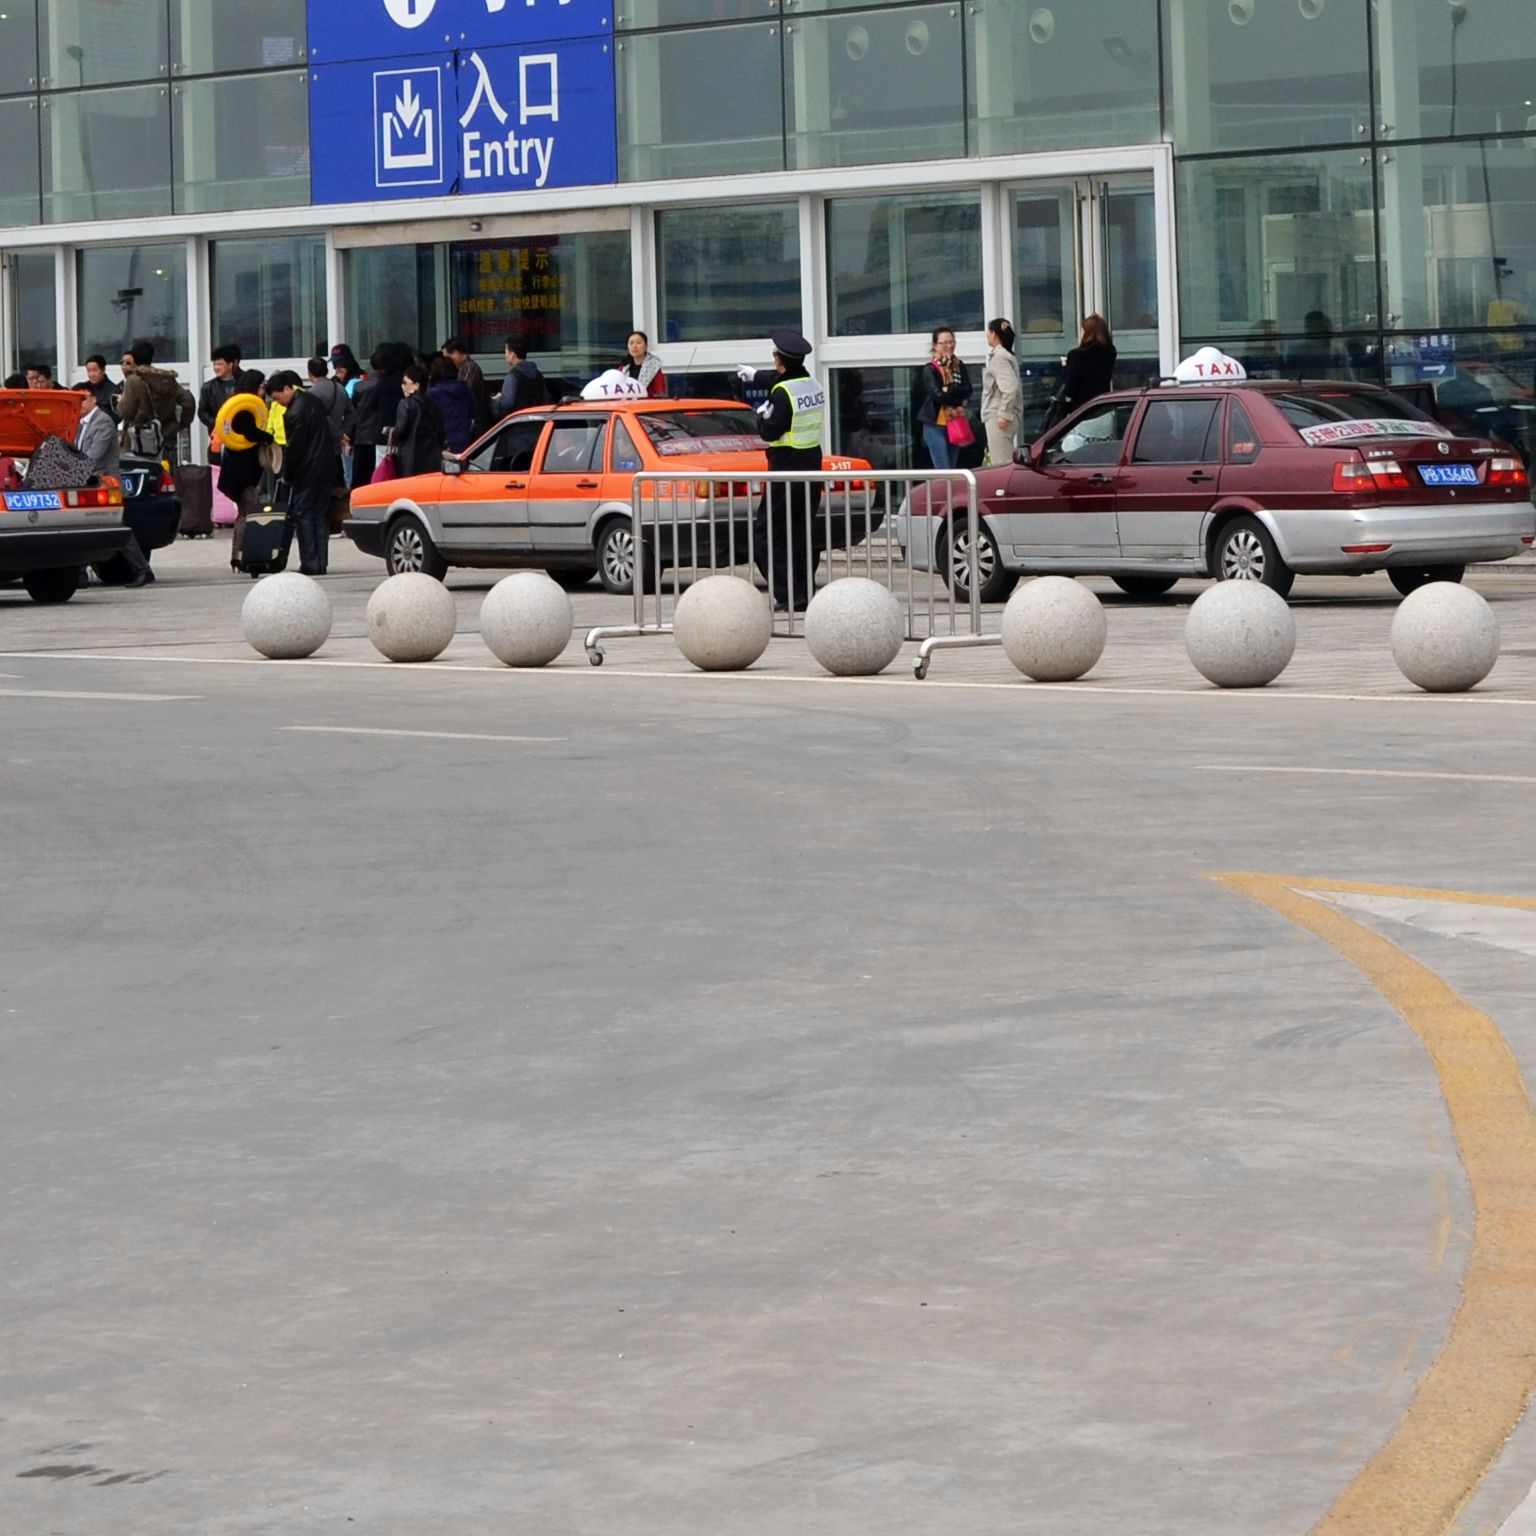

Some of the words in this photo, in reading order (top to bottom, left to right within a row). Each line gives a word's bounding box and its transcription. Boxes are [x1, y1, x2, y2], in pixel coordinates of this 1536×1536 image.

[459, 51, 559, 129] 入口
[463, 130, 554, 187] Entry
[1195, 362, 1241, 376] TAXI
[600, 383, 641, 396] TAXI
[797, 391, 825, 410] POLICE
